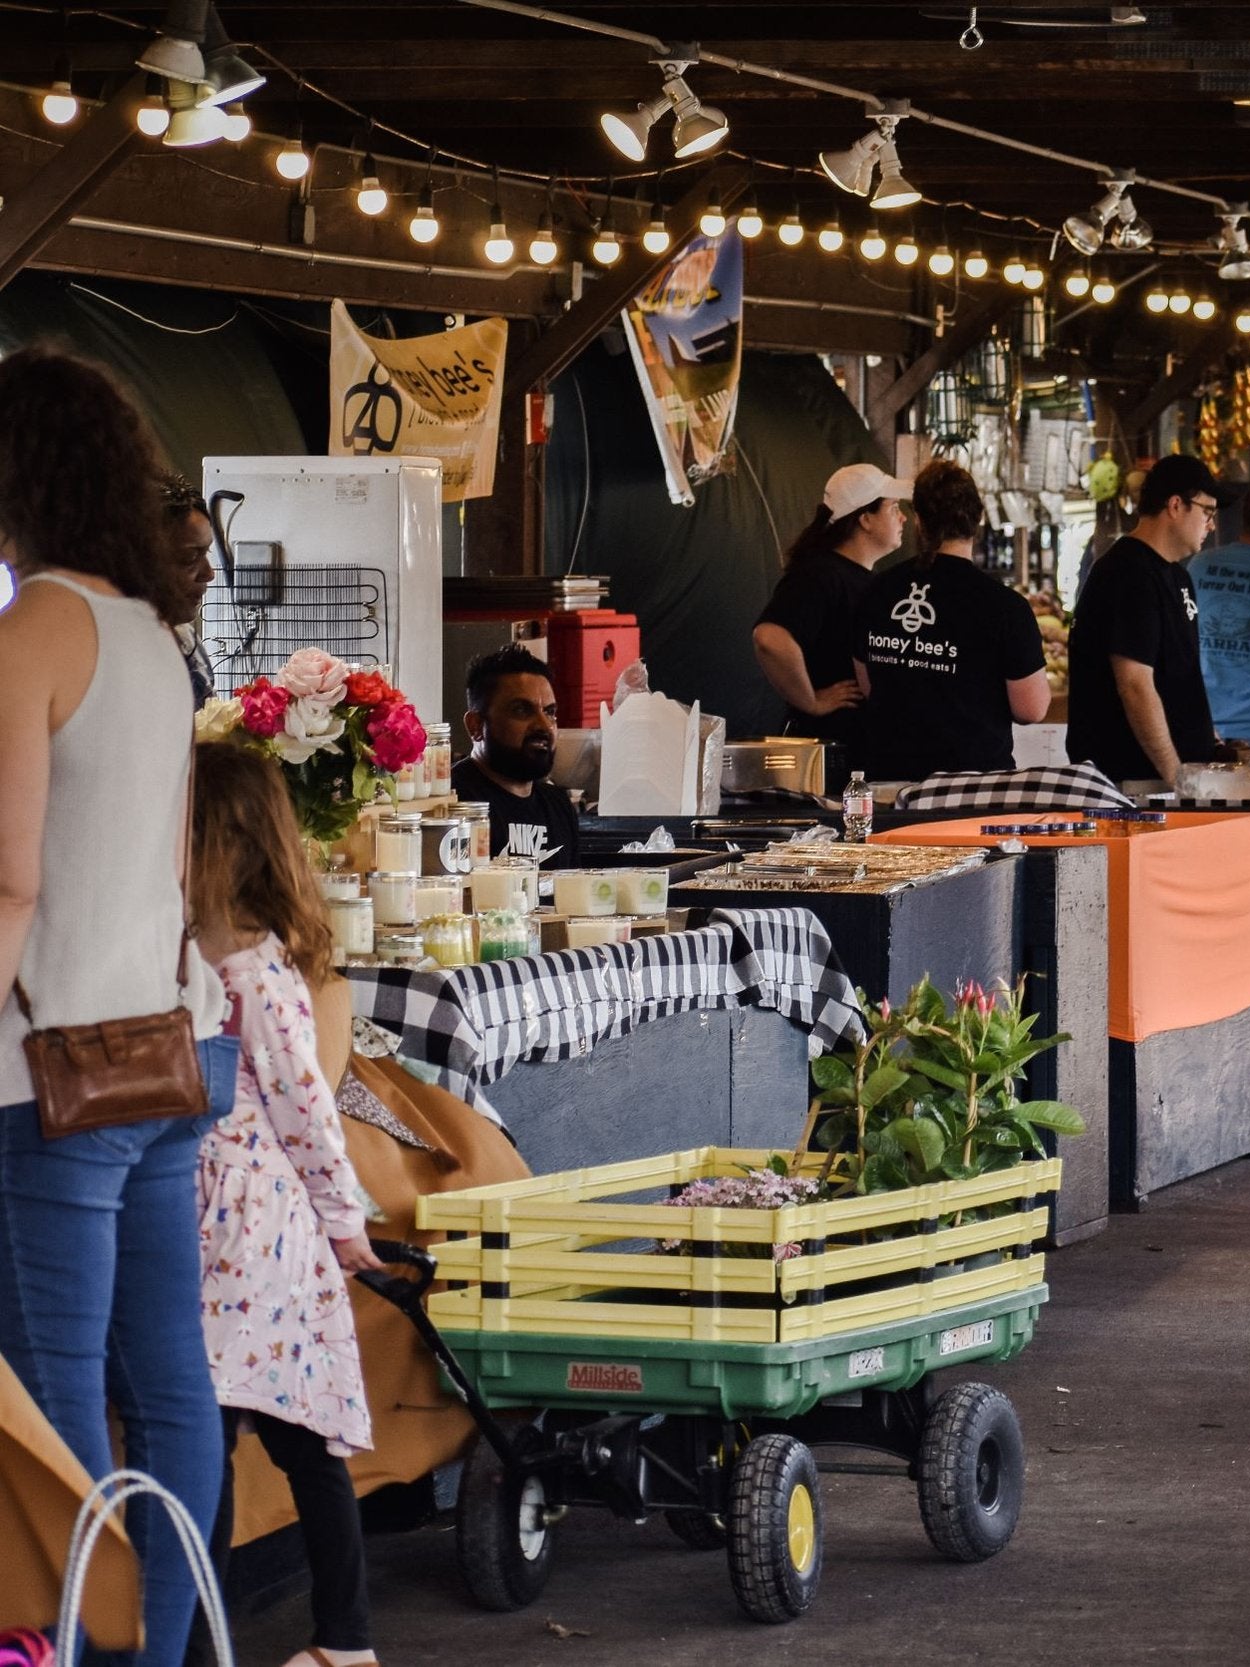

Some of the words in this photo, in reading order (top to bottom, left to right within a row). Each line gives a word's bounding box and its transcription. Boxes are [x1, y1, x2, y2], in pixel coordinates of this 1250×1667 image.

[869, 631, 911, 653] honey
[915, 636, 957, 657] bee's
[908, 659, 929, 668] good
[931, 663, 950, 672] eats
[508, 823, 548, 857] NIKE
